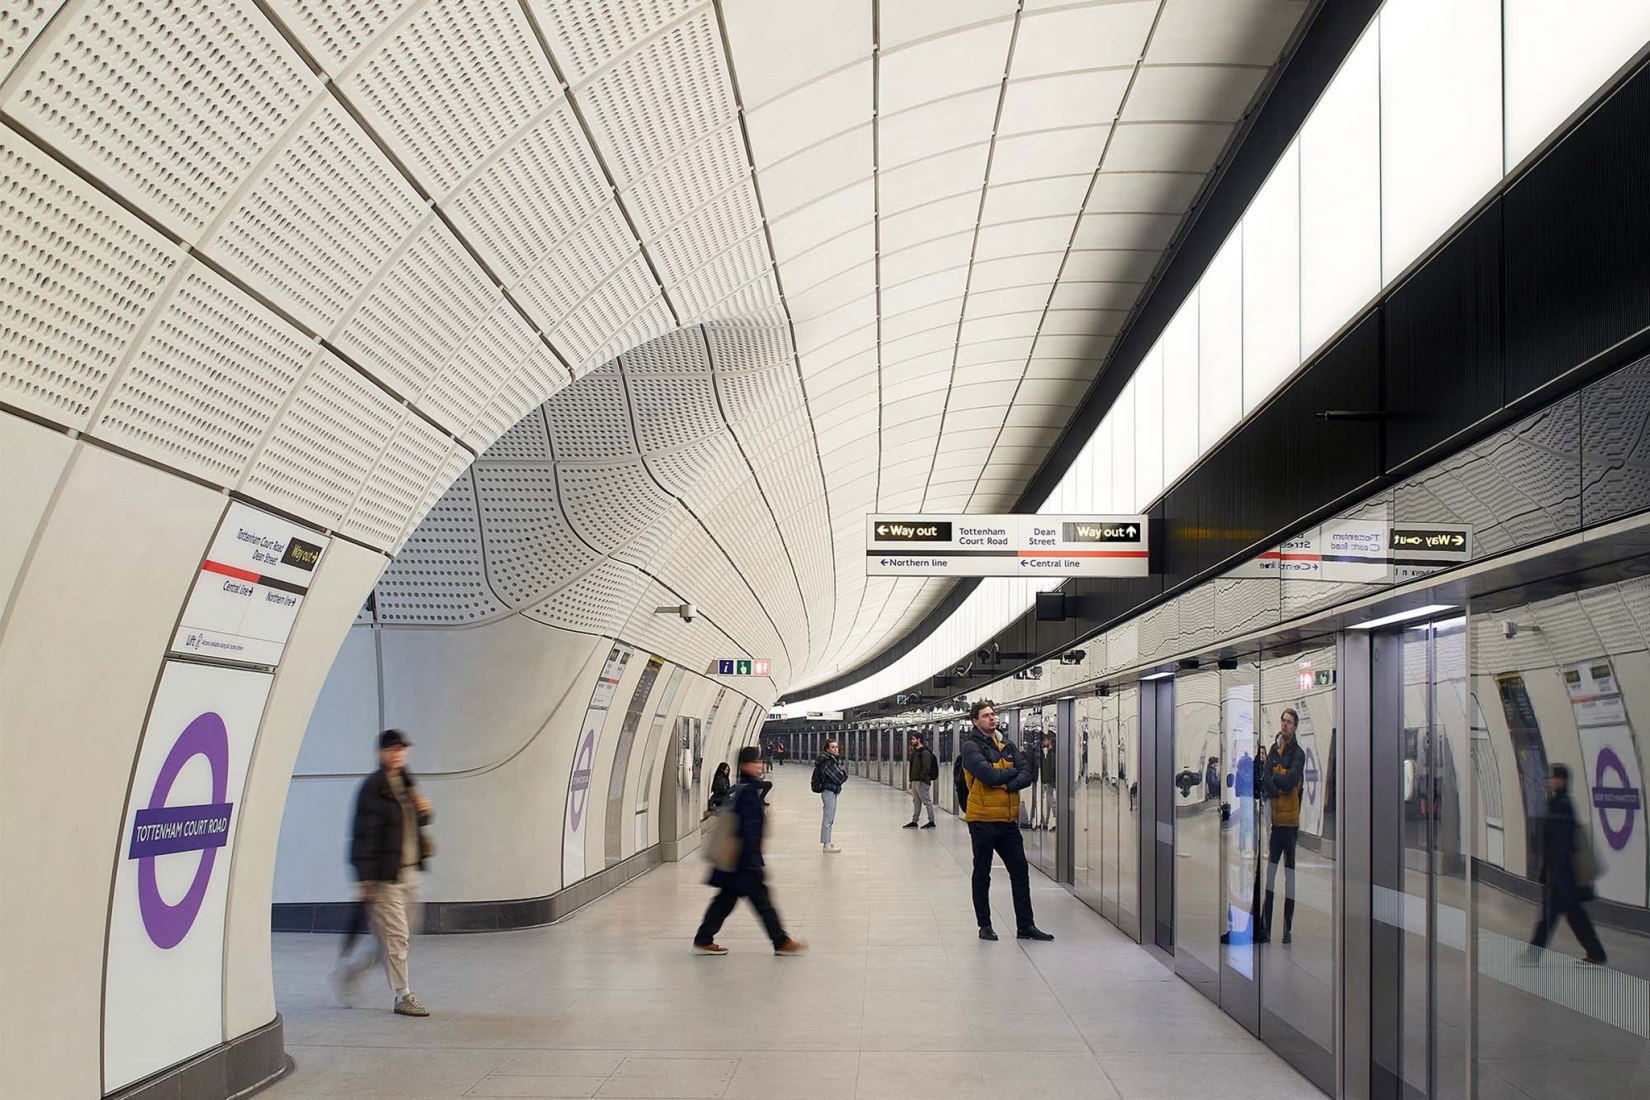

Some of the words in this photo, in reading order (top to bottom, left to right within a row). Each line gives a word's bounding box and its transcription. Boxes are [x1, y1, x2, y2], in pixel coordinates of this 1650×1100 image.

[890, 525, 915, 538] Way
[916, 526, 938, 536] out
[959, 527, 1006, 536] Tottenham
[1033, 528, 1056, 536] Dean
[1077, 526, 1102, 539] Way
[1104, 527, 1125, 537] out
[237, 528, 261, 545] Tottenham
[260, 537, 274, 549] Court
[273, 540, 285, 553] Road
[959, 537, 984, 545] Court
[987, 537, 1008, 545] Road
[1028, 537, 1056, 545] Street
[252, 549, 265, 561] Dean
[264, 553, 278, 566] Street
[291, 543, 304, 562] Way
[302, 551, 313, 562] out
[889, 559, 930, 567] Northern
[931, 559, 948, 567] line
[1029, 559, 1062, 567] Central
[223, 580, 241, 594] Central
[239, 584, 249, 596] line
[266, 591, 285, 604] Northern
[283, 596, 293, 607] line
[136, 821, 183, 842] TOTTENHAM
[183, 820, 208, 837] COURT
[208, 817, 227, 834] ROAD
